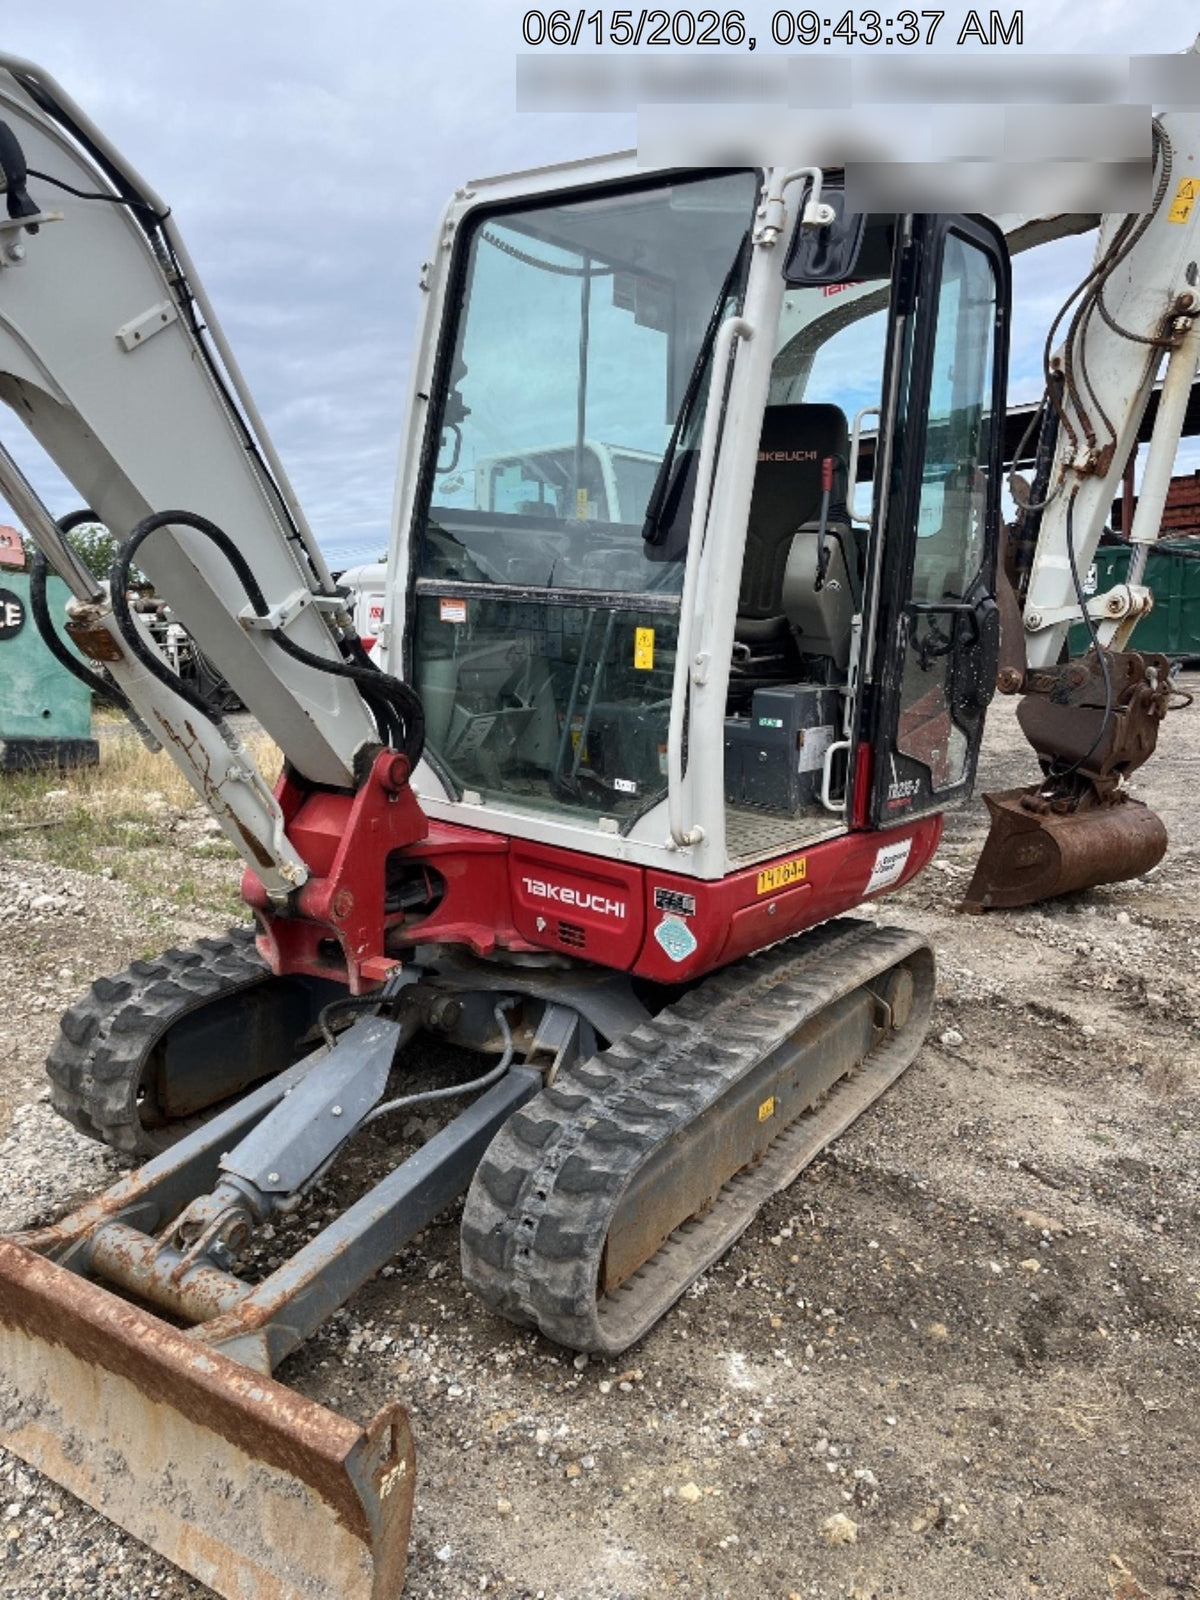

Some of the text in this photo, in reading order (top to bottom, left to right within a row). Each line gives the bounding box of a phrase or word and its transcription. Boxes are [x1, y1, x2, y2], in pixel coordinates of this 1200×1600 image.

[757, 450, 818, 462] AKEUCHI
[760, 860, 805, 890] 147644
[522, 877, 626, 918] TAKEUCHI
